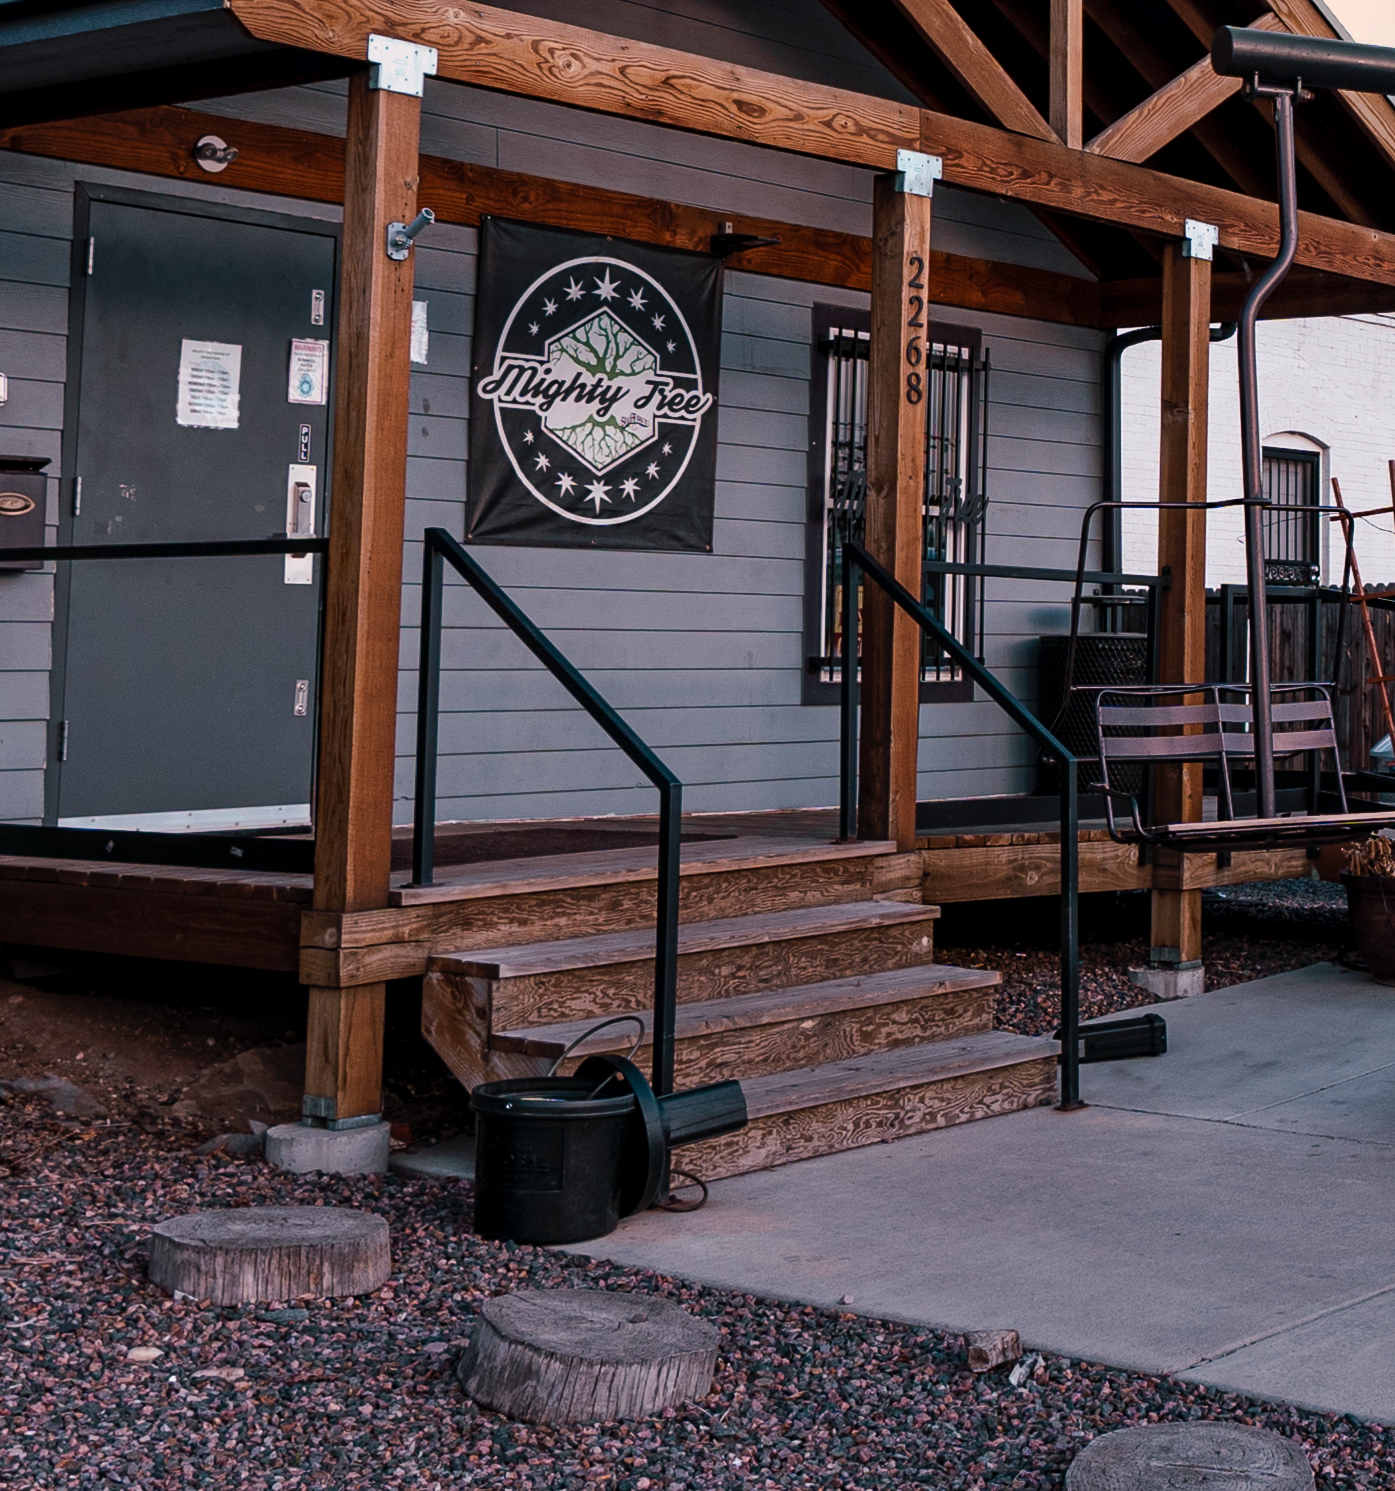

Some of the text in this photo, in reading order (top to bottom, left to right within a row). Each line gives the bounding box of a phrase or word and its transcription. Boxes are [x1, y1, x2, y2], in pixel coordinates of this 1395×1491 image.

[906, 256, 925, 405] 2268
[481, 363, 711, 418] Mighty Tree
[301, 426, 309, 460] PULL
